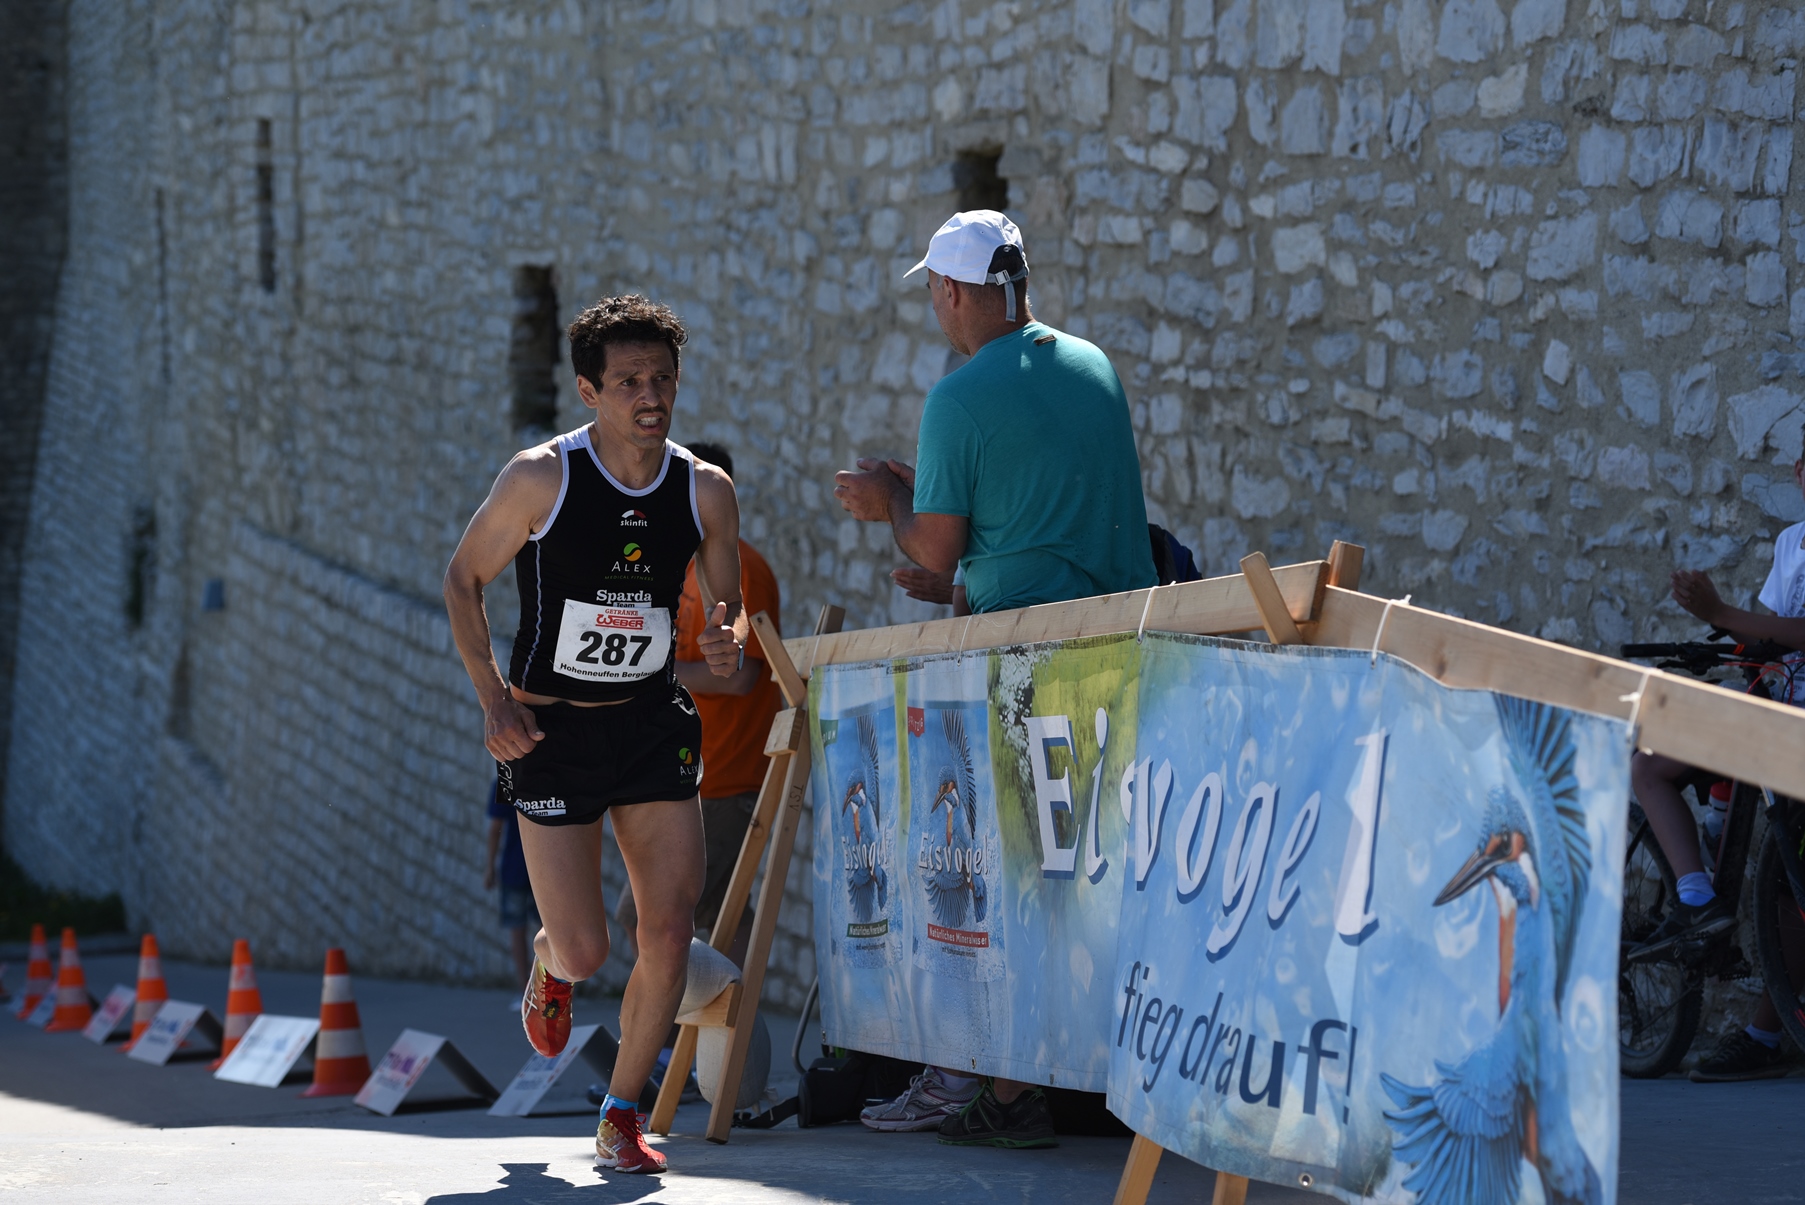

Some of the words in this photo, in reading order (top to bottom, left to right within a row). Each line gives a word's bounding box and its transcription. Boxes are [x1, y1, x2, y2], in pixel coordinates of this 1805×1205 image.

[620, 519, 648, 527] skinfit
[611, 560, 651, 574] ALEX
[596, 589, 653, 605] Sparda
[604, 608, 639, 616] GETRÄNKE
[596, 613, 644, 629] WEBER
[575, 630, 653, 666] 287
[560, 662, 620, 678] Hohenneuffen
[513, 796, 567, 812] Sparda
[918, 831, 989, 883] Eisvogel
[1179, 992, 1358, 1125] drauf!
